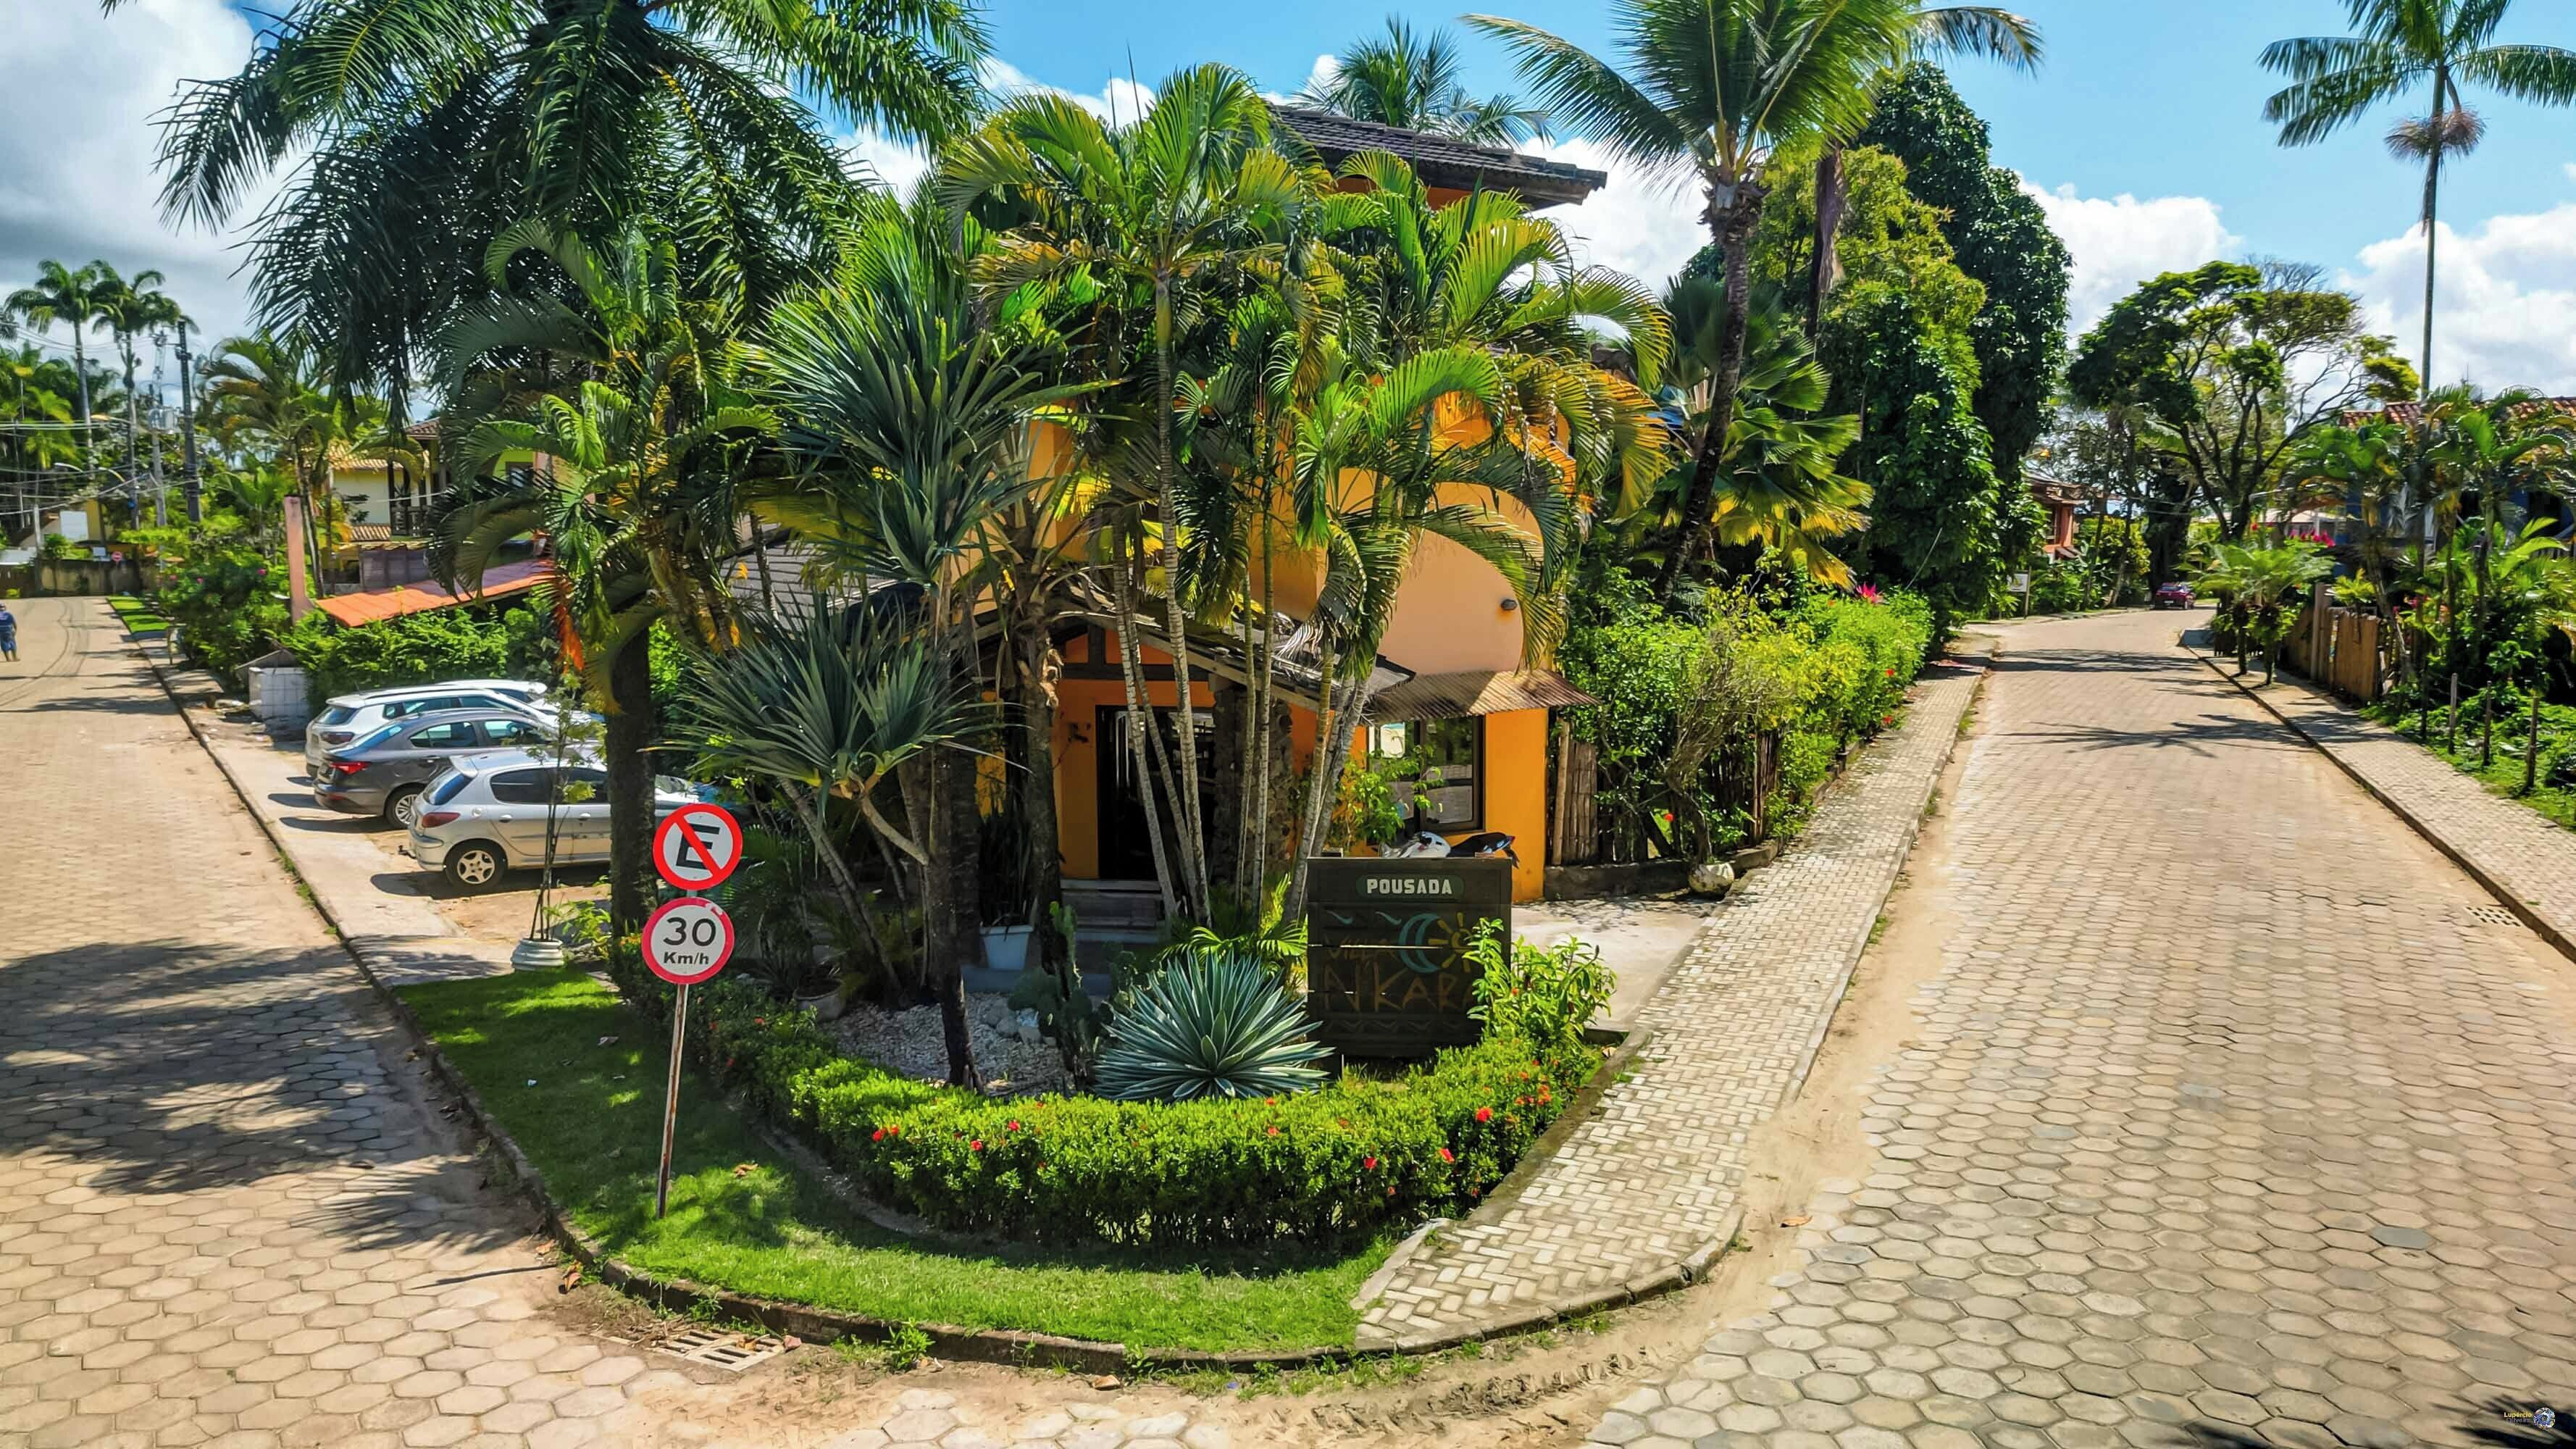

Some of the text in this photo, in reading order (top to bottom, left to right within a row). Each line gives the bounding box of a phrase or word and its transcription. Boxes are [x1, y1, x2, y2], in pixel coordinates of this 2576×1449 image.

[676, 823, 719, 869] E
[1367, 879, 1452, 894] POUSADA
[664, 916, 716, 946] 30
[664, 951, 709, 965] Km/h
